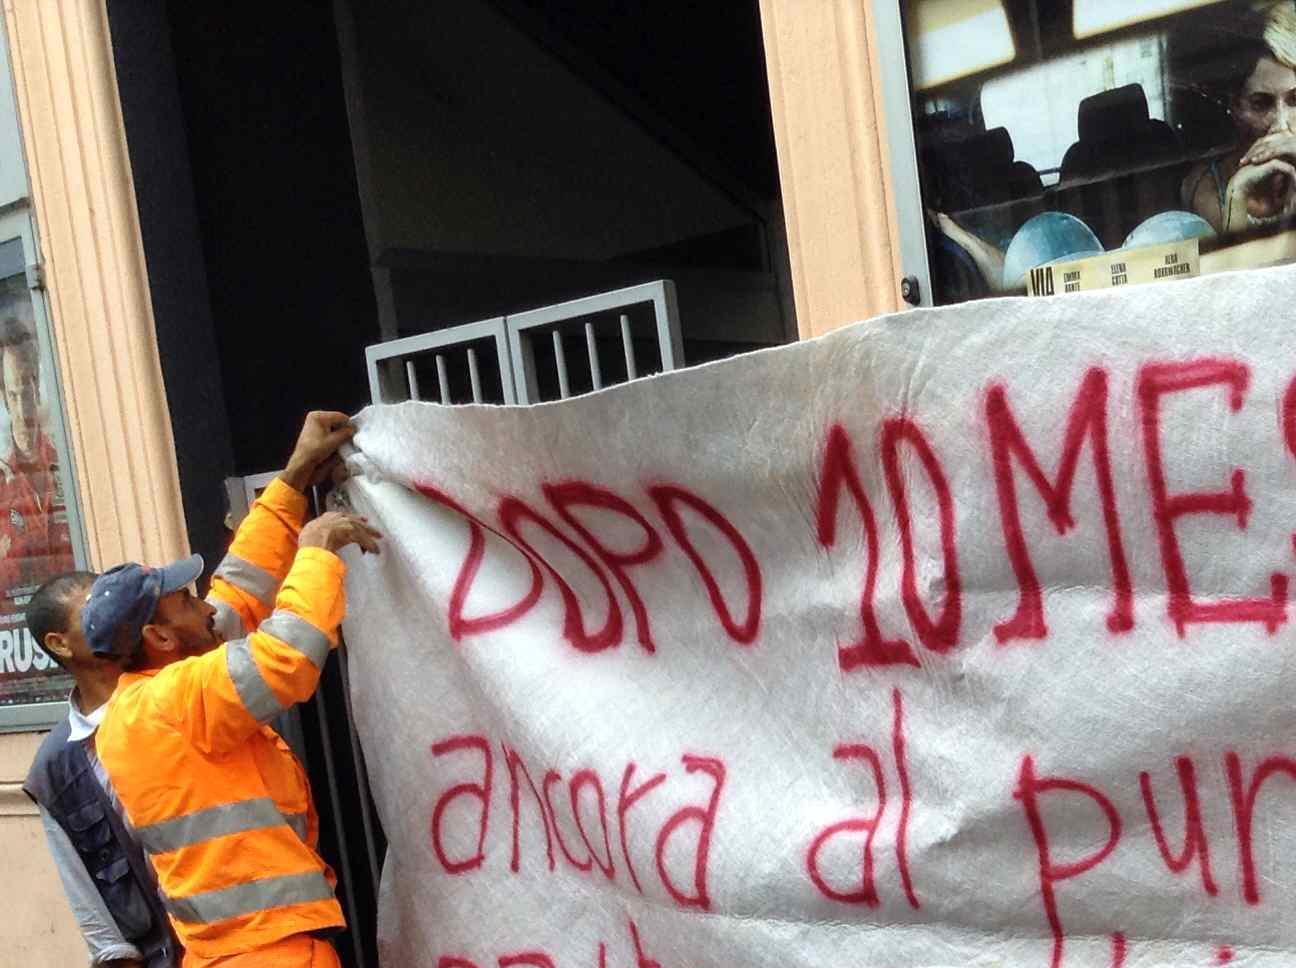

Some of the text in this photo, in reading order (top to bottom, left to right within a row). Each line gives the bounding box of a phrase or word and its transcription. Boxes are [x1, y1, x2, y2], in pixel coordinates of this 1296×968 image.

[1030, 266, 1055, 296] VIA
[414, 477, 764, 656] DOPO
[813, 412, 965, 674] 10
[0, 628, 59, 673] RUS
[431, 734, 726, 908] ancora
[805, 687, 918, 908] al
